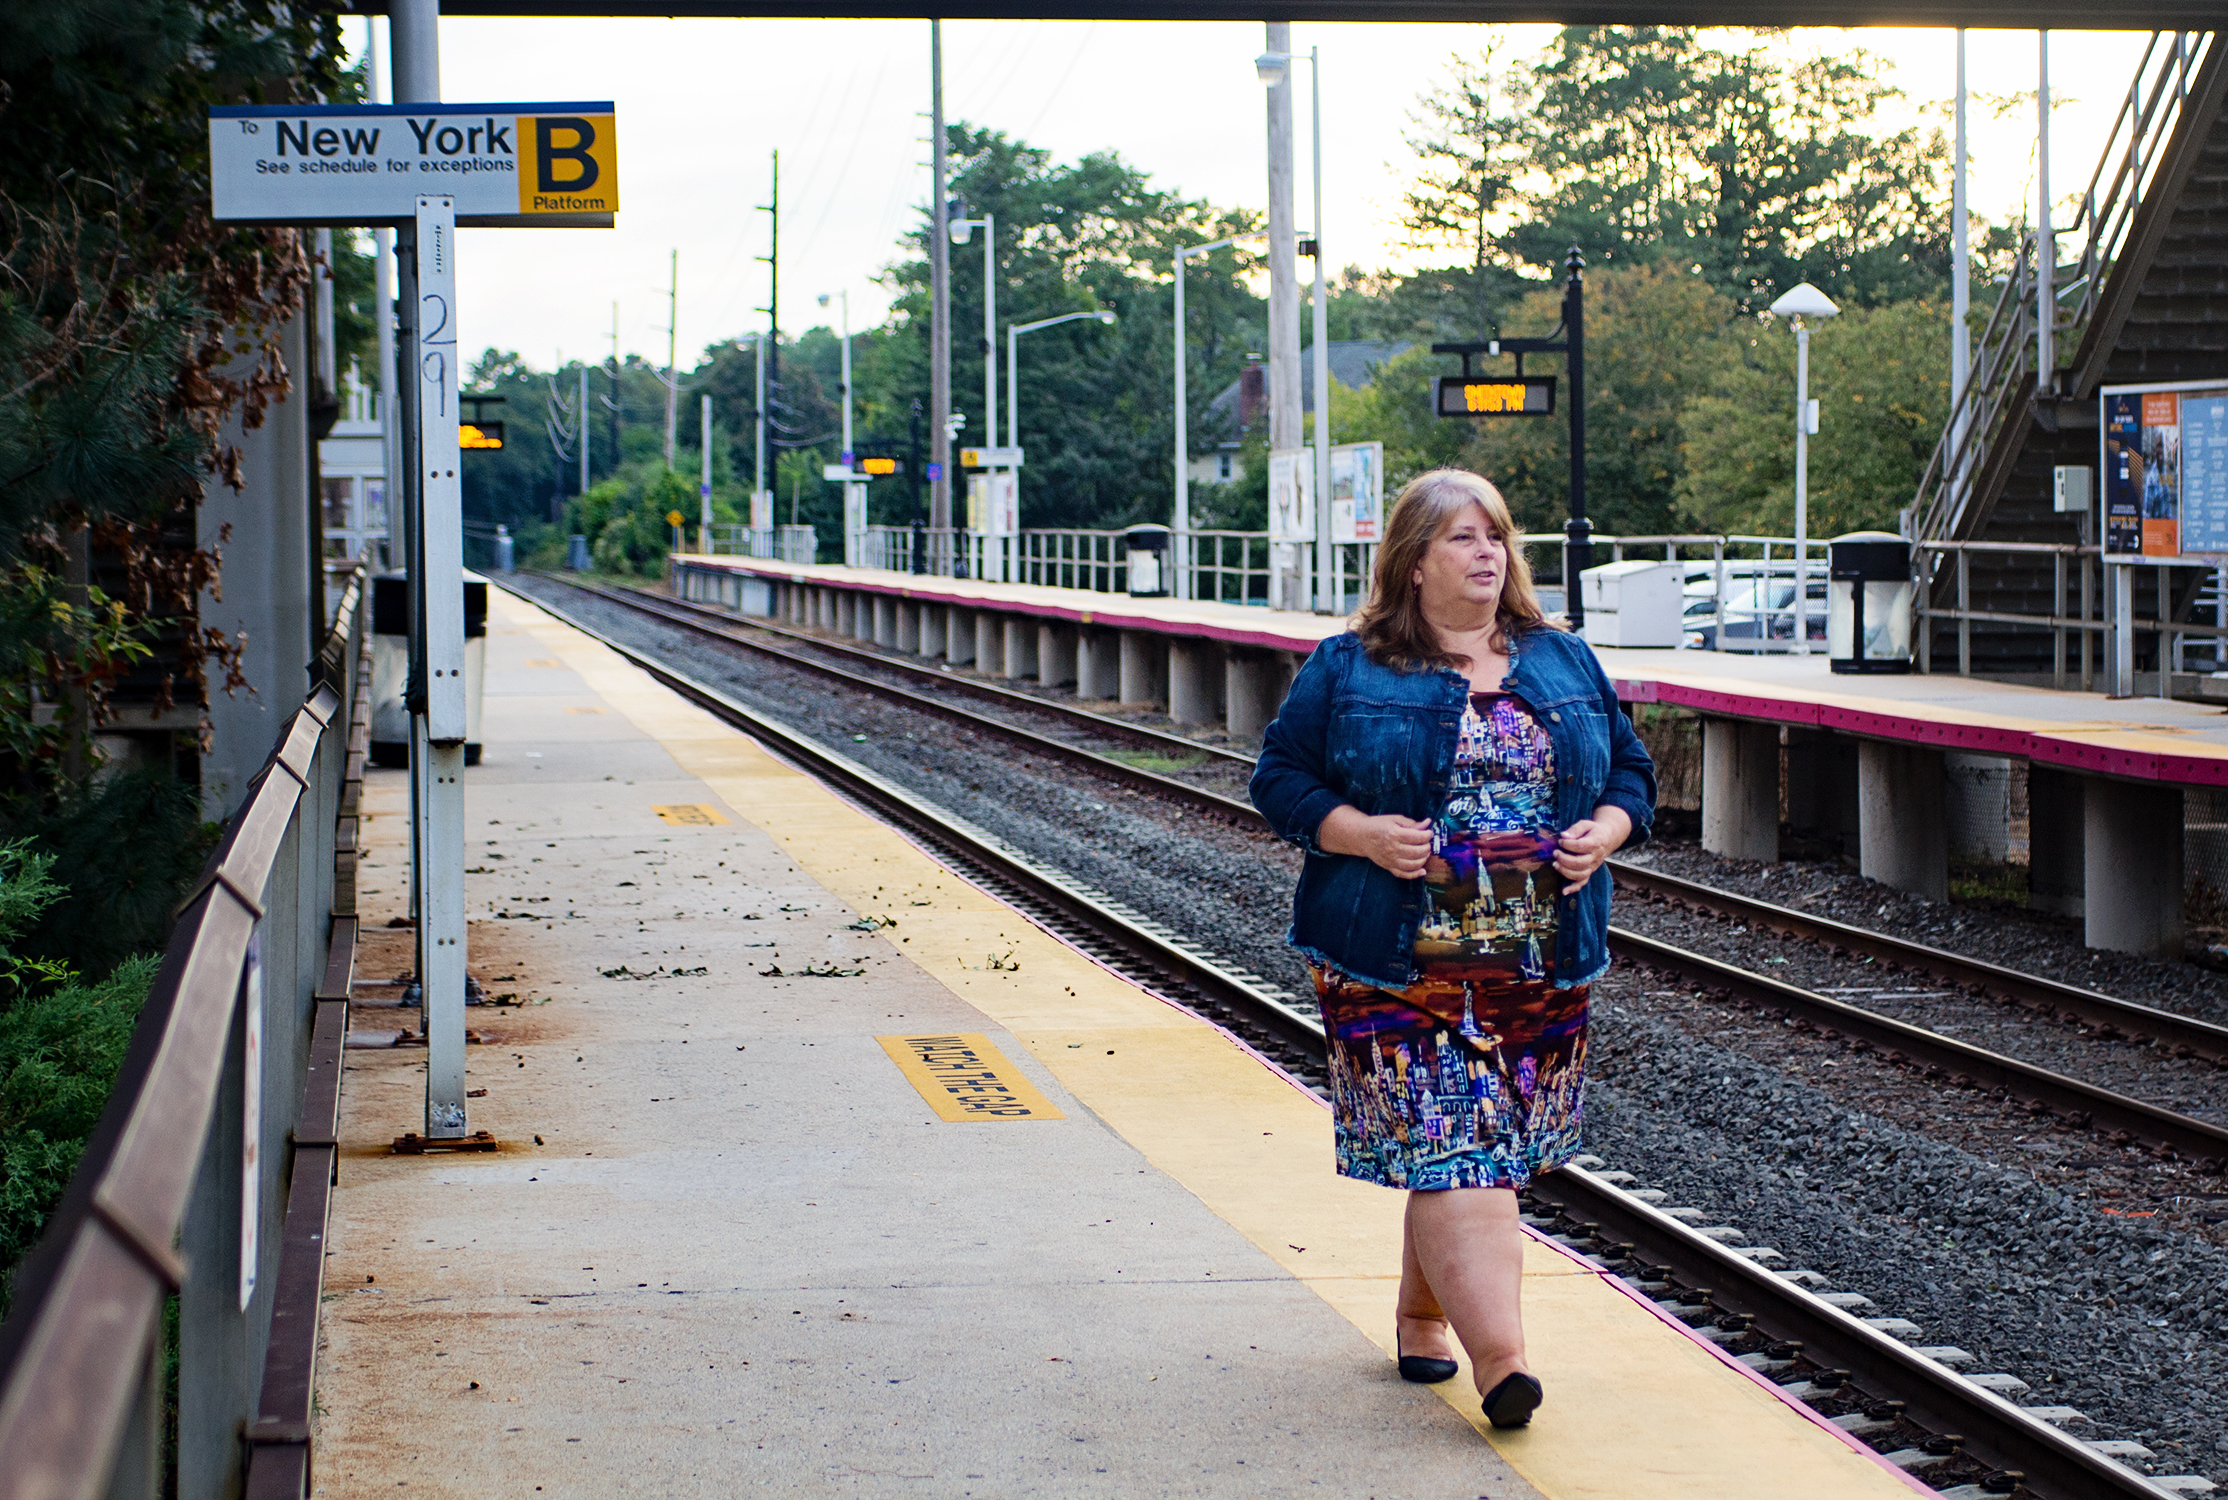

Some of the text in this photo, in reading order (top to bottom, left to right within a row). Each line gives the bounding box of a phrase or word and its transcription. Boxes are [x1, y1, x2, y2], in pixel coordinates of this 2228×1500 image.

[238, 117, 513, 157] To New York
[535, 117, 600, 193] B
[255, 156, 515, 175] See schedule for exceptions
[533, 195, 606, 211] Platform
[904, 1036, 1032, 1116] WATCH THE GAP
